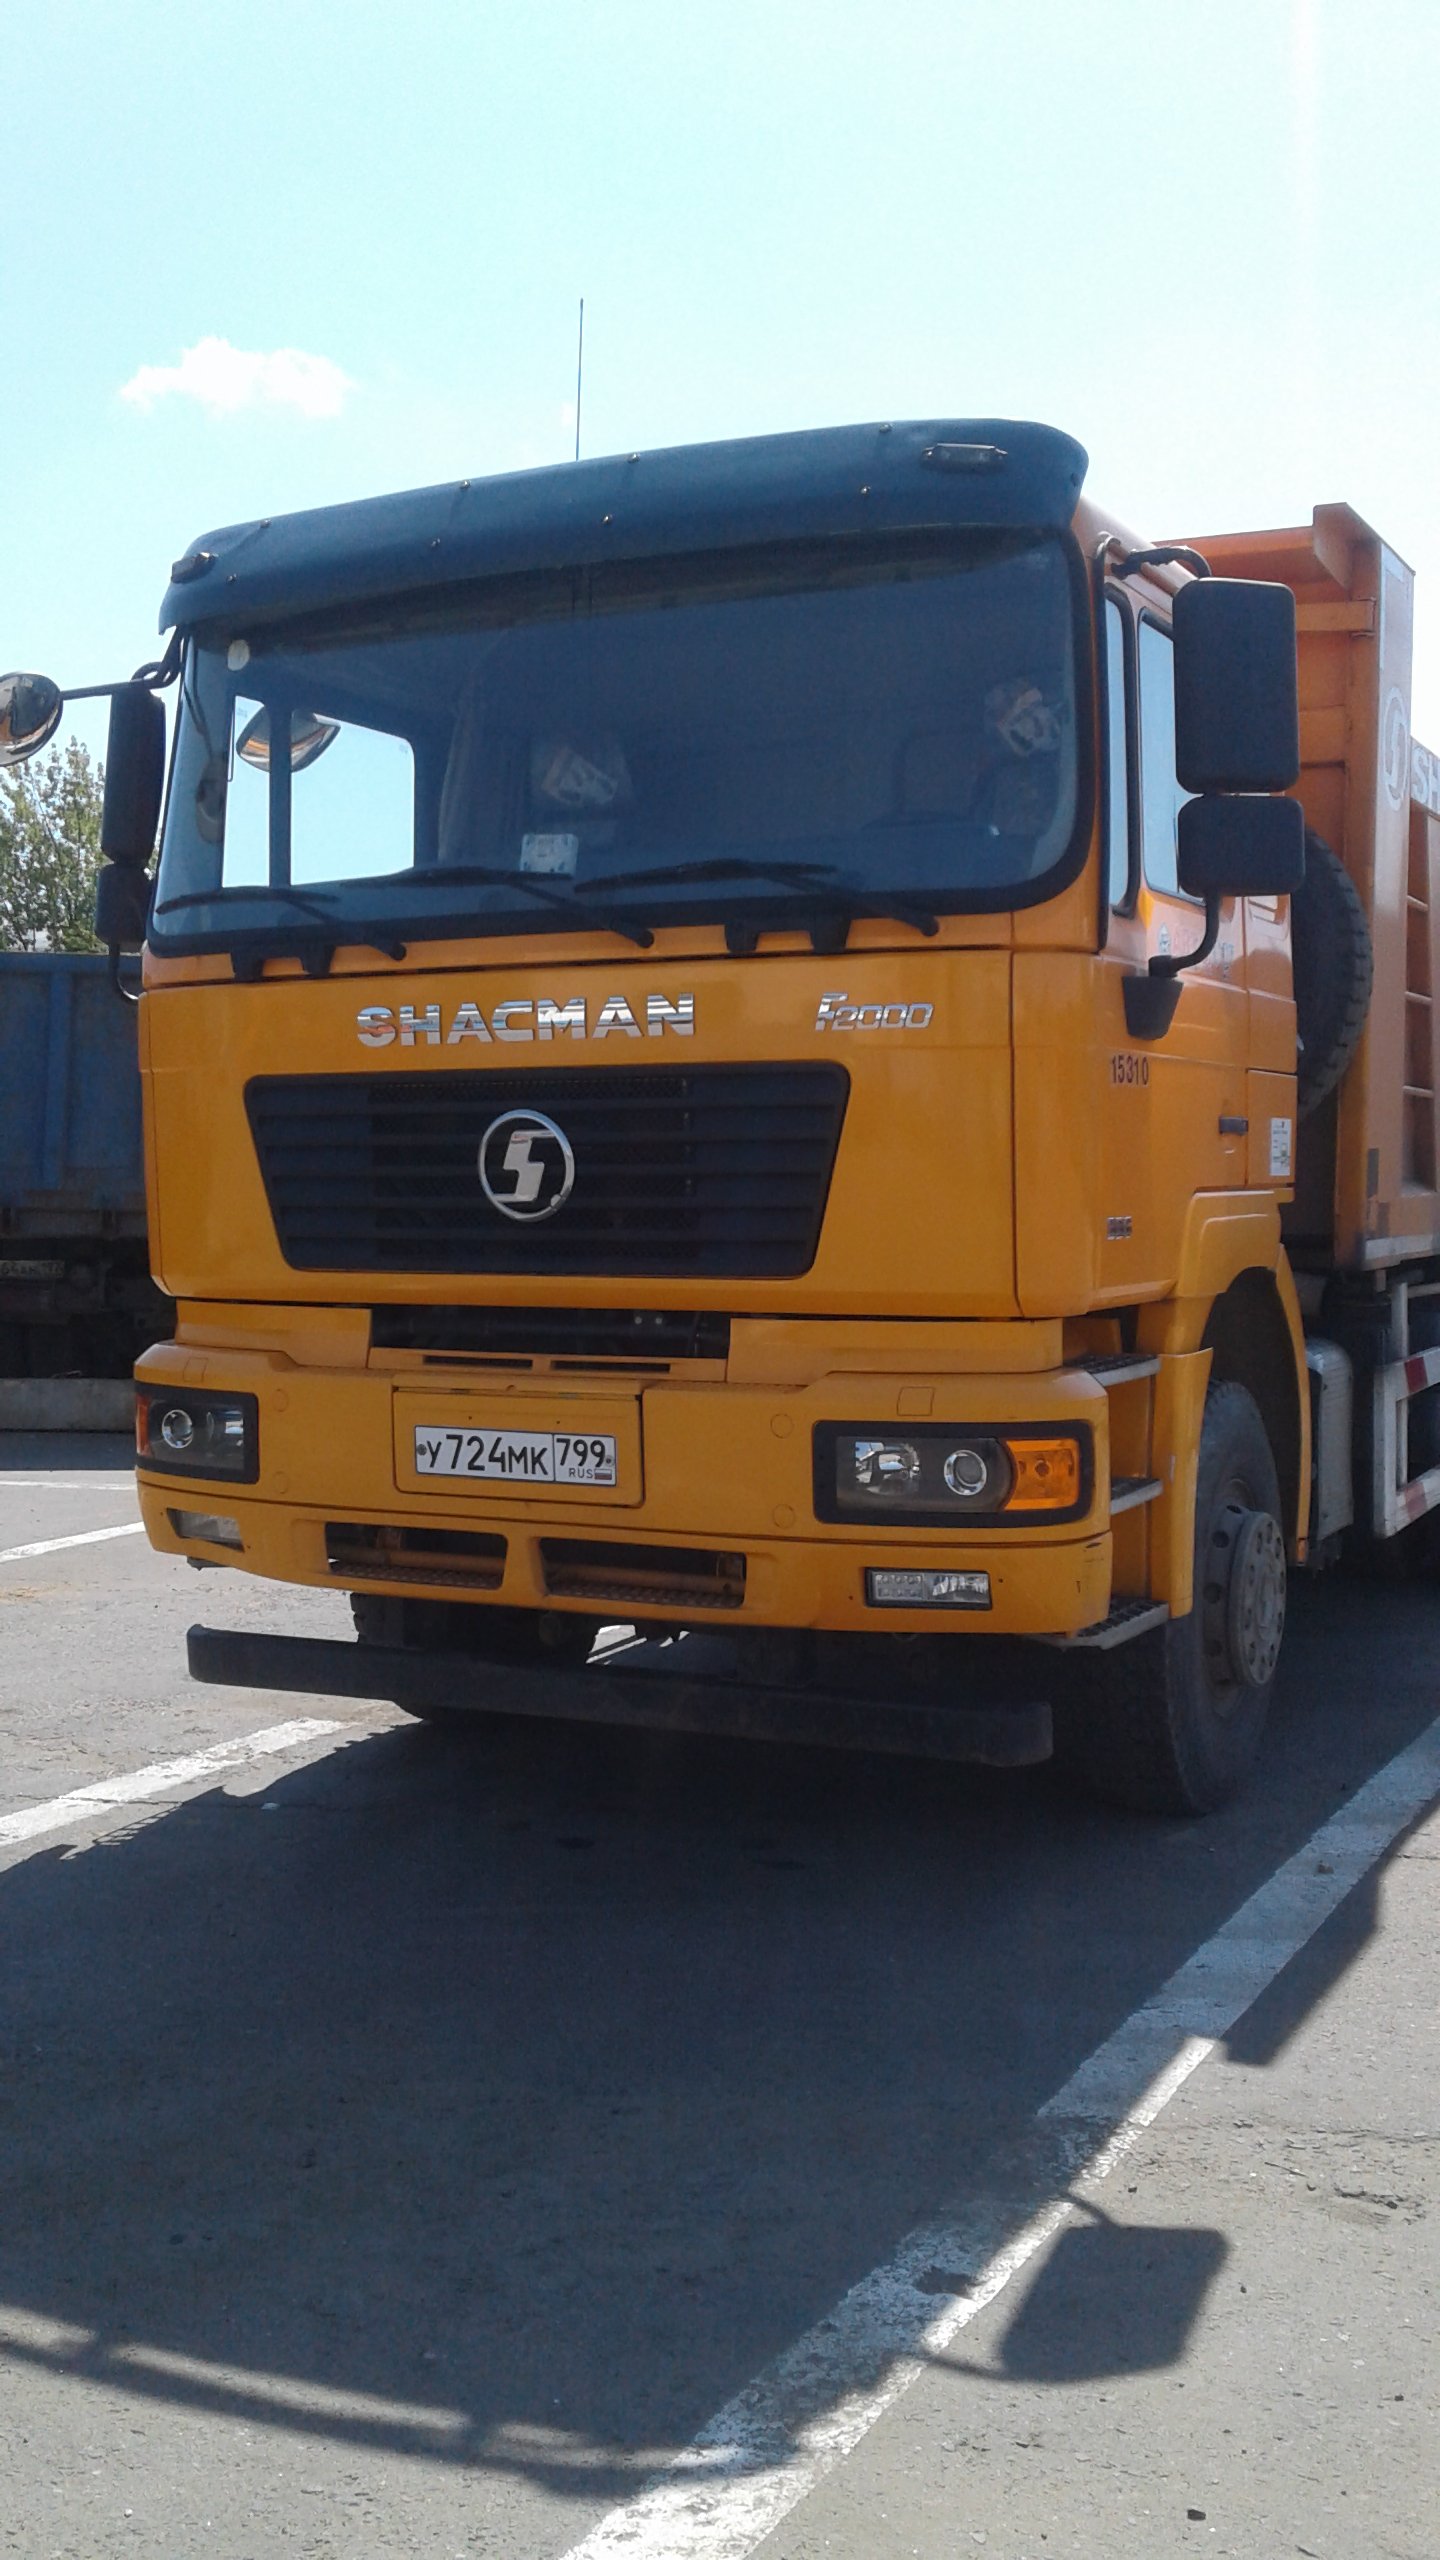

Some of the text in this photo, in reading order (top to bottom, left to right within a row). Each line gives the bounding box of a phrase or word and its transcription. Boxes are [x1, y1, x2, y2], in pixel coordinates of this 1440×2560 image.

[356, 993, 695, 1048] SHACMAN
[815, 992, 934, 1031] F2000
[1112, 1055, 1149, 1086] 15310
[556, 1437, 606, 1468] 799
[568, 1467, 594, 1479] RUS
